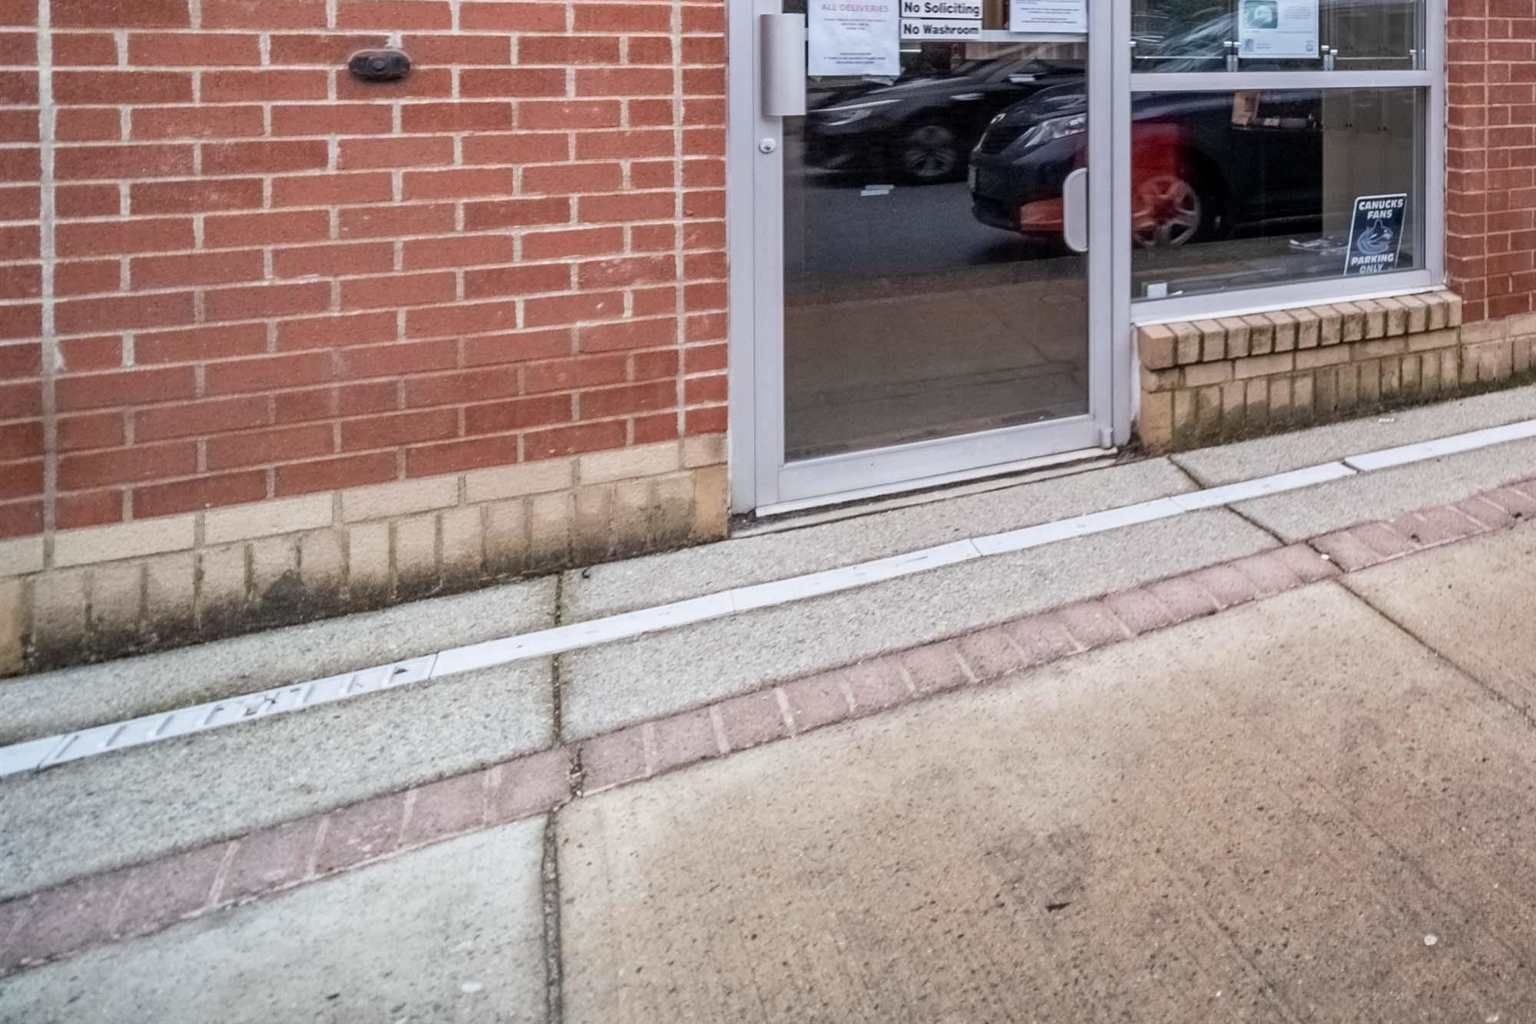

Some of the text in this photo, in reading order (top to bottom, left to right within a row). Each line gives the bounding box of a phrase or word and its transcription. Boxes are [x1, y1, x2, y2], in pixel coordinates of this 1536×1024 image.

[821, 3, 889, 13] ALL DELIVERIES
[904, 2, 980, 16] No Soliciting
[904, 23, 979, 35] No Washroom
[1358, 199, 1404, 211] CANUCKS
[1367, 209, 1393, 220] FANS
[1351, 253, 1394, 266] PARKING
[1360, 263, 1384, 273] ONLY
